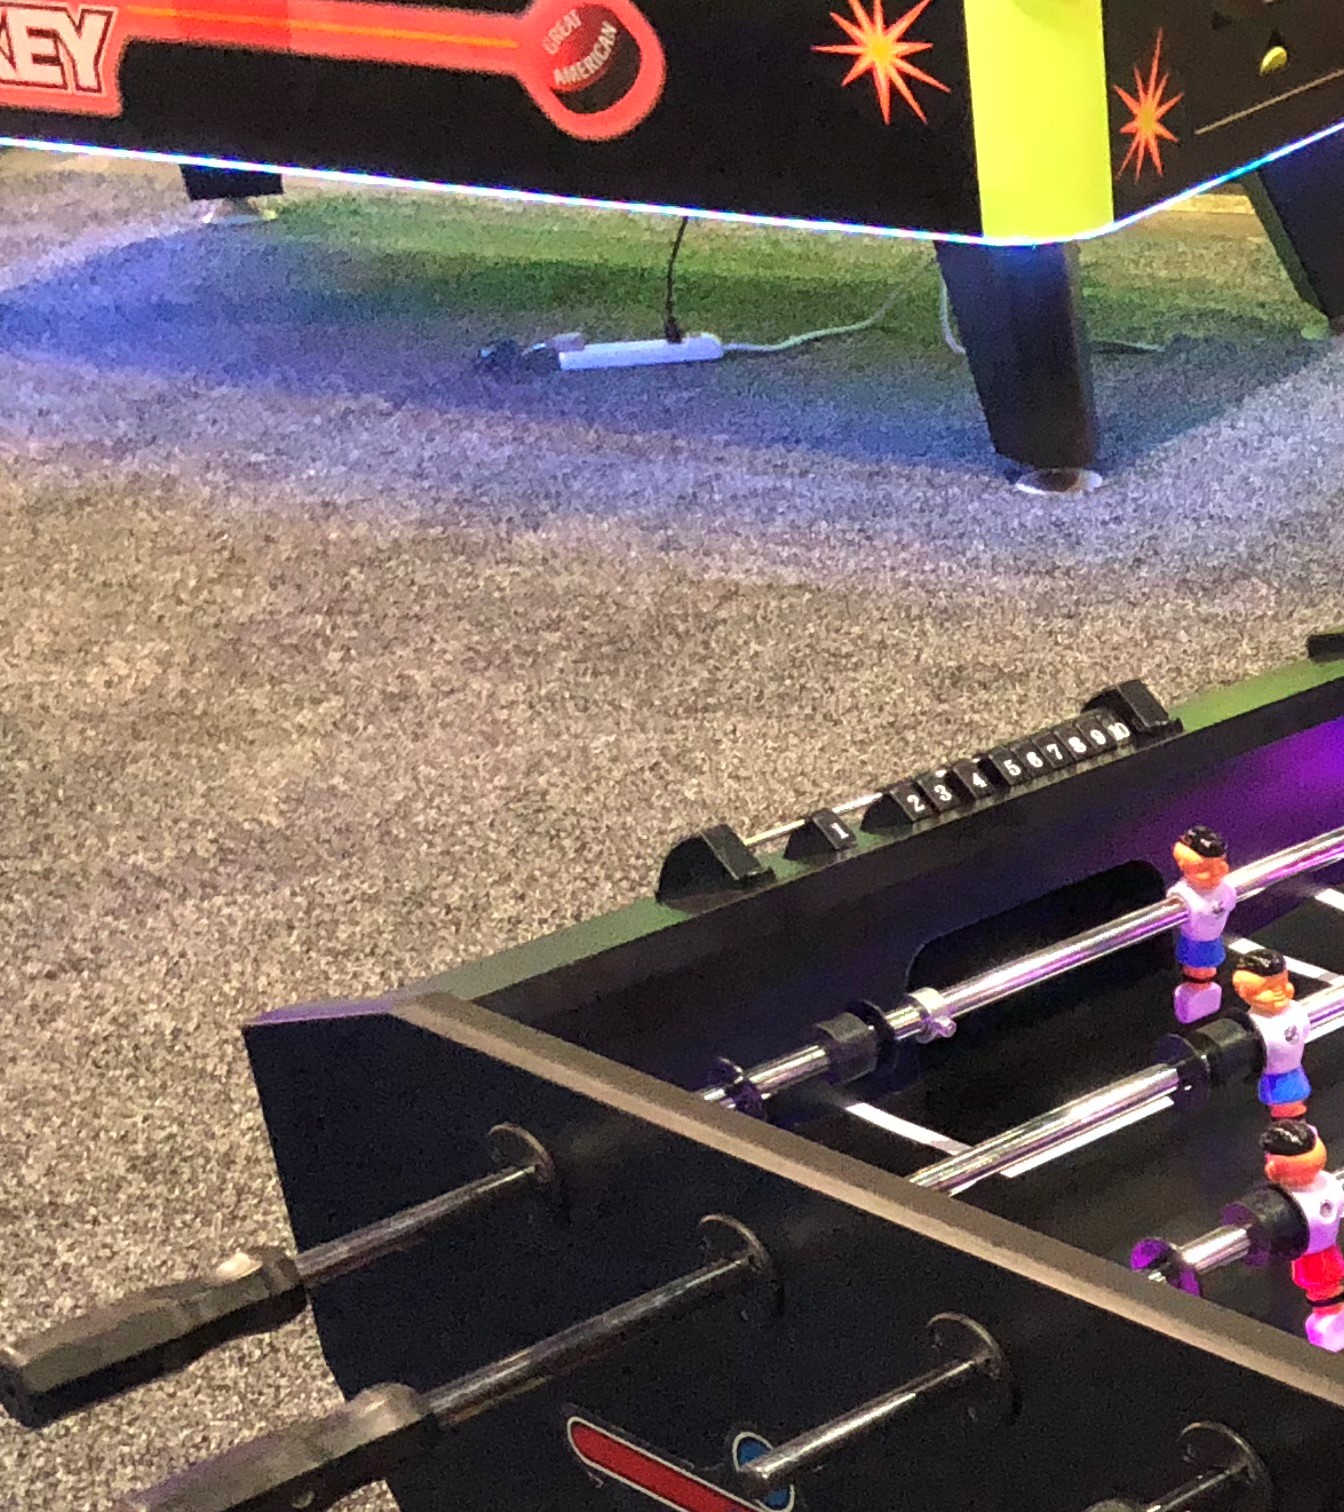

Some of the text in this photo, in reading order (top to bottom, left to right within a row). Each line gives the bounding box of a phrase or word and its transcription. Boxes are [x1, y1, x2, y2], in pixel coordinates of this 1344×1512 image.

[553, 20, 617, 85] AMERICAN
[830, 722, 1131, 839] 1 2 3 4 5 6 7 8 9 10
